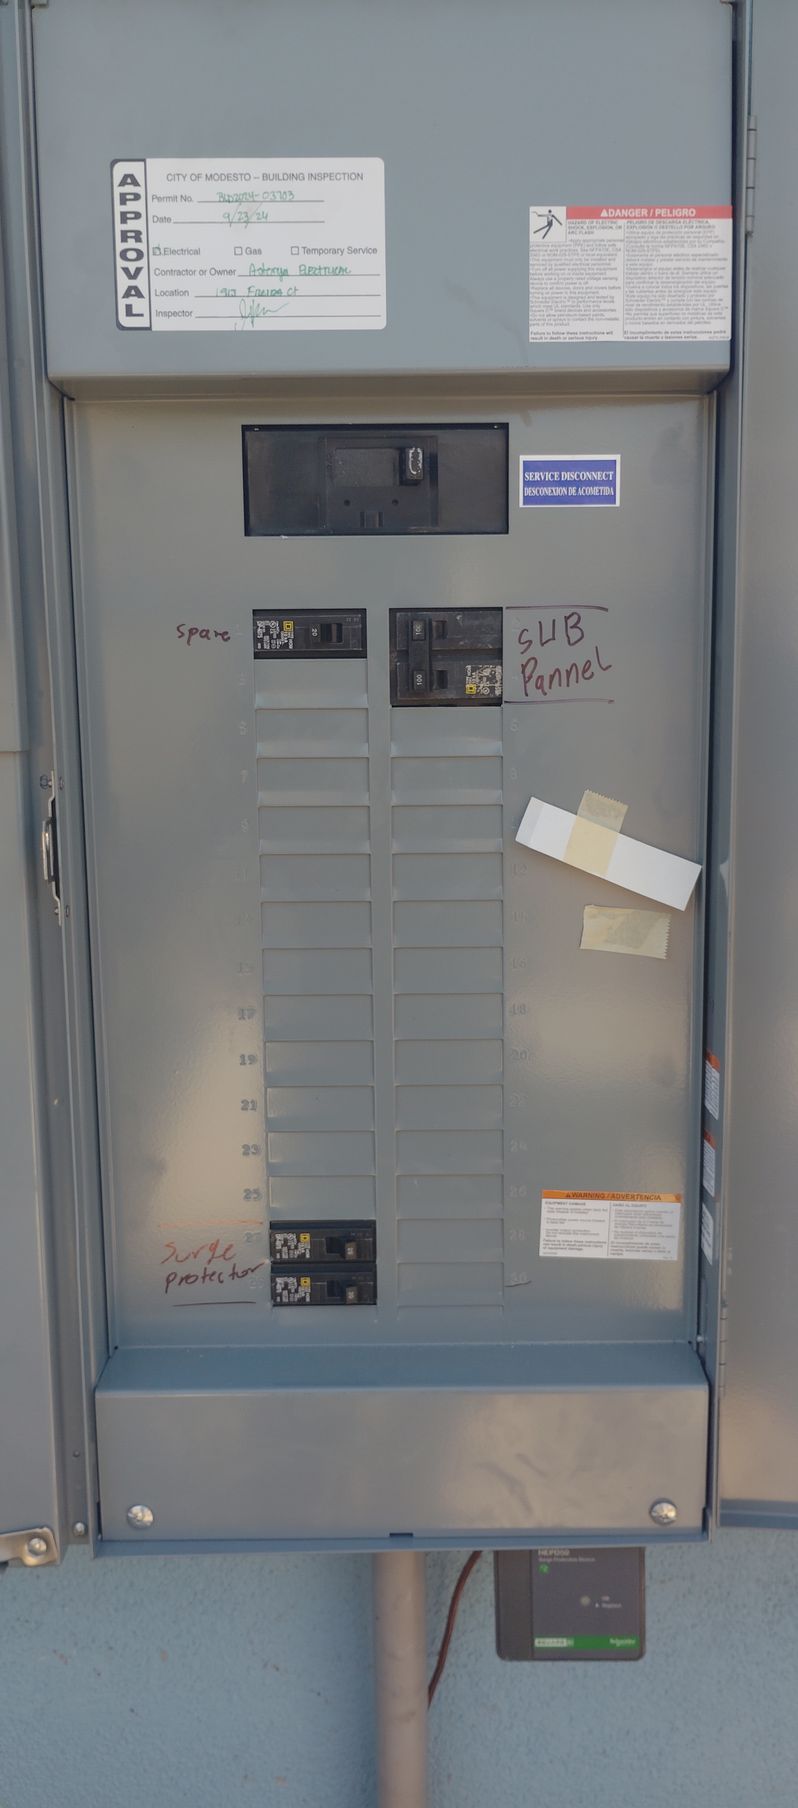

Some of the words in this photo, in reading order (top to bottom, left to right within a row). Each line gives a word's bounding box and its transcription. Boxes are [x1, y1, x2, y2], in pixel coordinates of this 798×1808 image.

[166, 173, 188, 182] CITY
[190, 173, 203, 182] OF
[205, 173, 252, 182] MODESTO
[262, 173, 305, 181] BUILDING
[307, 173, 364, 181] INSPECTION
[151, 195, 179, 203] Permit
[608, 208, 649, 217] DANGER
[655, 208, 696, 217] PELIGRO
[152, 215, 172, 224] Date
[117, 173, 146, 317] APPROVAL
[164, 247, 201, 256] Electrical
[244, 247, 262, 255] Gas
[302, 246, 344, 256] Temporary
[347, 246, 378, 255] Service
[153, 268, 198, 277] Contractor
[209, 268, 236, 277] Owner
[154, 289, 190, 297] Location
[155, 309, 193, 318] Inspector
[524, 472, 560, 481] SERVICE
[561, 471, 614, 480] DISCONNECT
[524, 487, 567, 496] DESCONEXION
[568, 487, 577, 496] DE
[578, 486, 614, 495] ACOMETIDA
[239, 1054, 257, 1066] 19
[240, 1100, 258, 1111] 21
[241, 1144, 259, 1156] 23
[243, 1188, 261, 1200] 25
